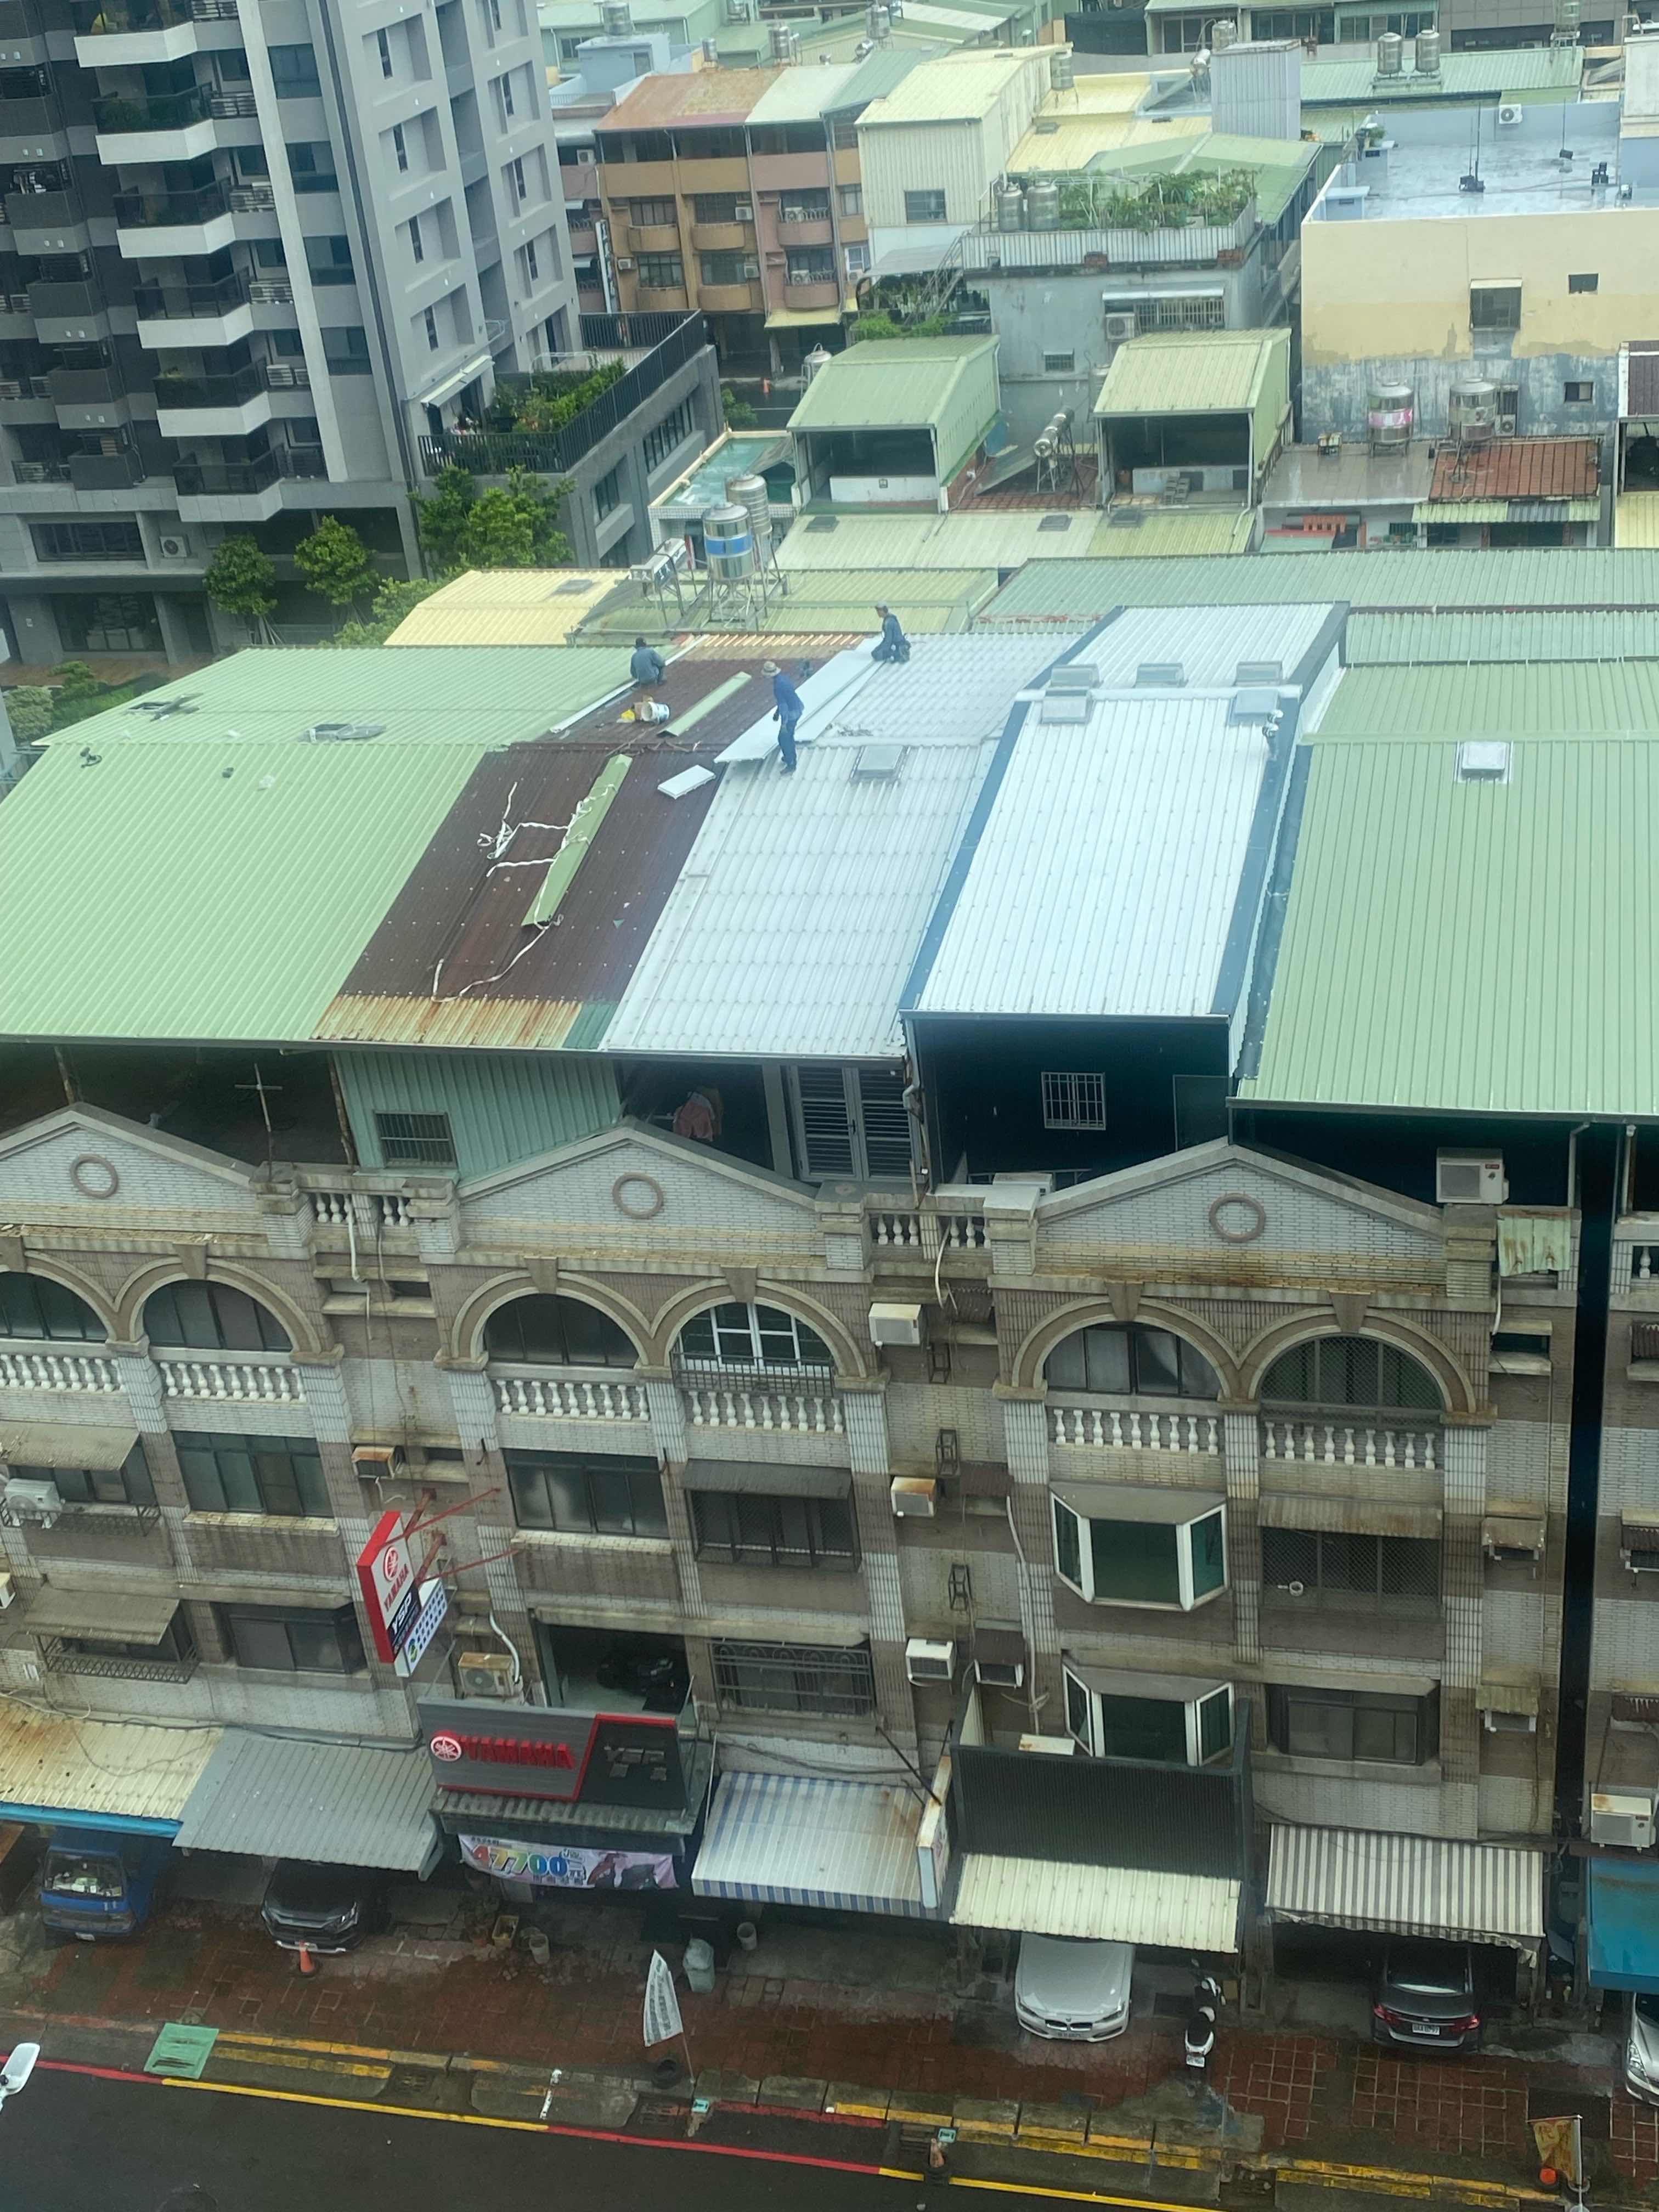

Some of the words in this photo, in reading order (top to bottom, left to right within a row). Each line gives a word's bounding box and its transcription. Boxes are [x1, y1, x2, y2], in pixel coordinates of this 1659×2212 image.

[384, 1564, 409, 1612] YAMAHA
[392, 1592, 412, 1633] YSP
[461, 1736, 575, 1770] YAMAHA
